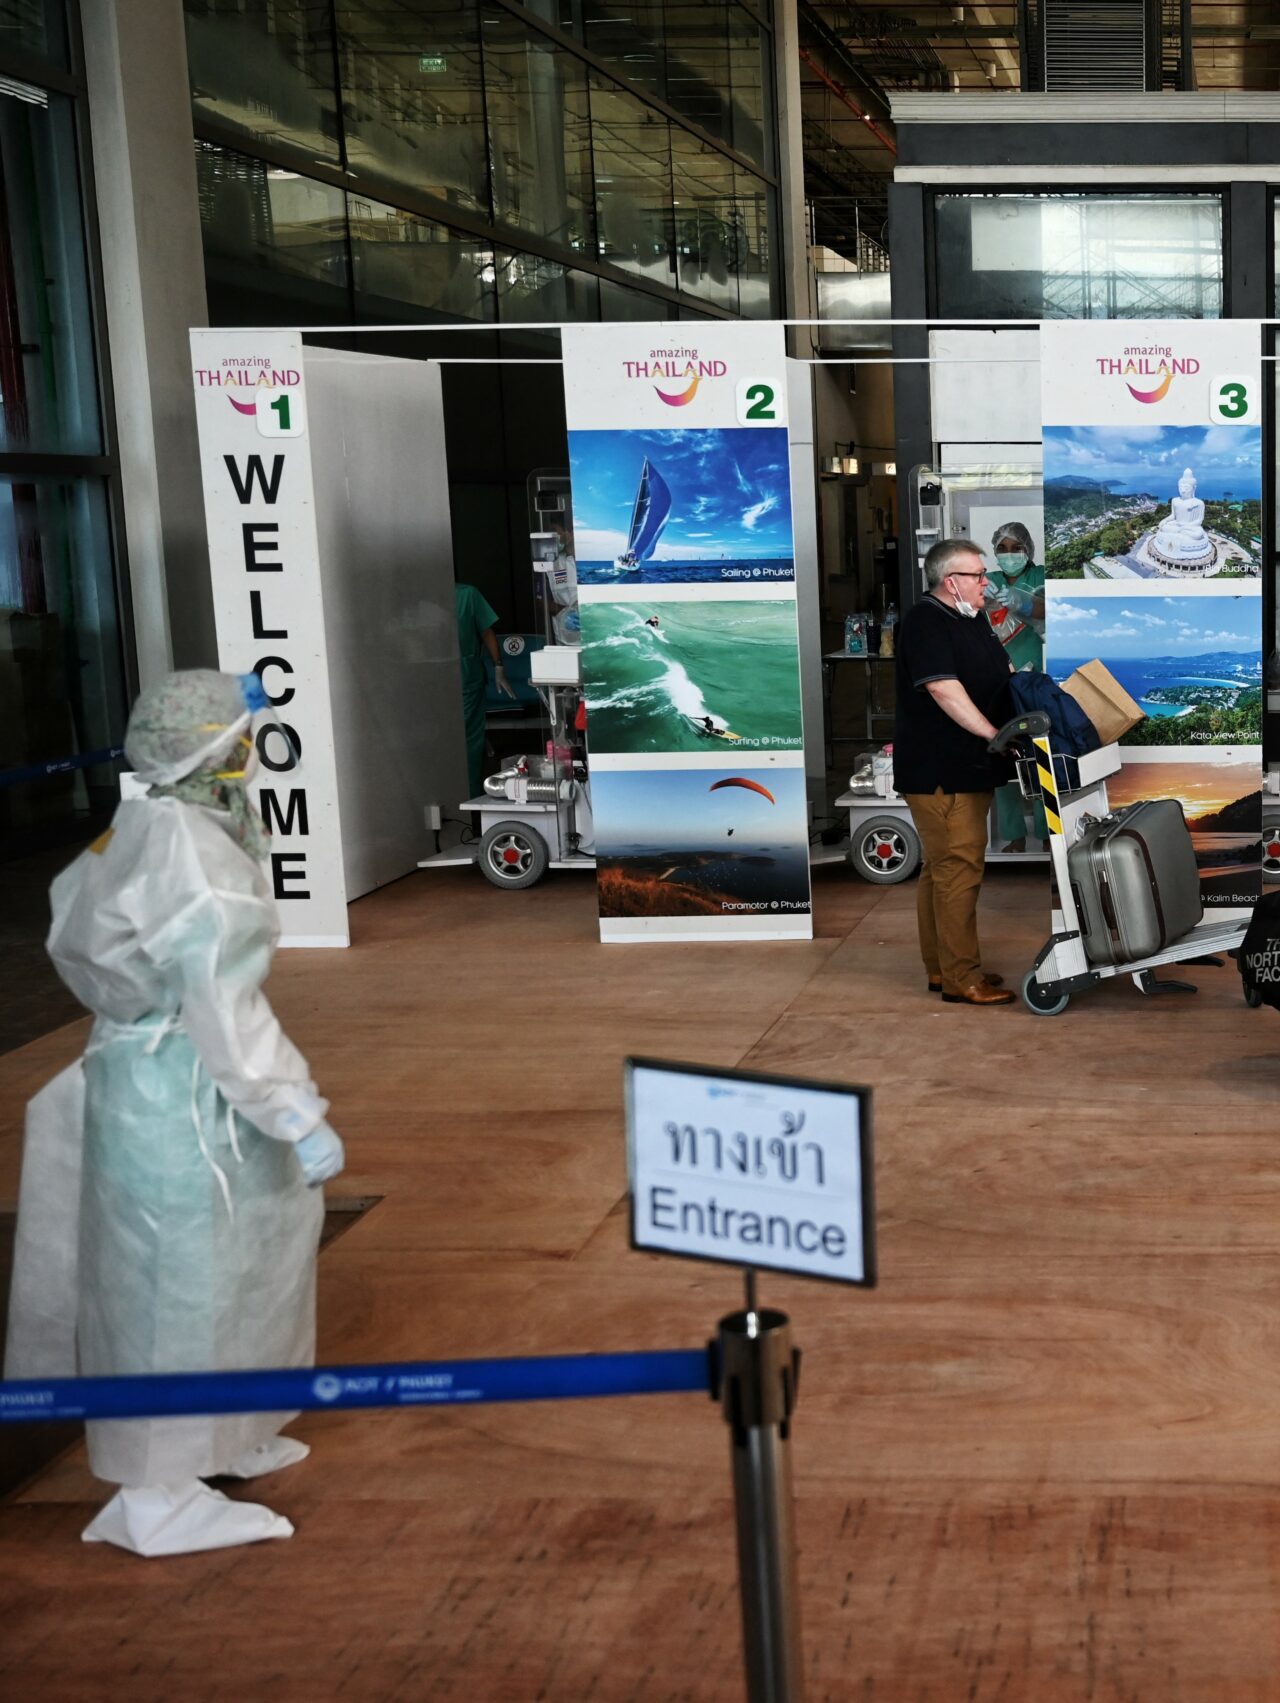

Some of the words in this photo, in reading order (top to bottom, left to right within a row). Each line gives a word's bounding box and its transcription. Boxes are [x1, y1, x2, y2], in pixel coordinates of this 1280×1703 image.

[650, 347, 698, 360] amazing
[1124, 345, 1172, 357] amazing
[222, 356, 271, 369] amazing
[623, 361, 727, 377] THAILAND
[1096, 358, 1200, 375] THAILAND
[195, 370, 300, 386] THAILAND
[746, 384, 776, 419] 2
[1218, 383, 1248, 418] 3
[271, 395, 291, 430] 1
[721, 568, 751, 578] Sailing
[762, 568, 794, 576] Phuket
[1221, 564, 1259, 573] Buddha
[223, 454, 311, 900] WELCOME
[728, 736, 760, 746] Surfing
[771, 736, 803, 745] Phuket
[1190, 731, 1212, 740] Kata
[1213, 731, 1236, 739] View
[1237, 730, 1260, 739] Point
[722, 901, 769, 910] Paramotor
[780, 900, 811, 909] Phuket
[1207, 894, 1230, 903] Kalim
[663, 1110, 826, 1187] ทางเข้า
[649, 1184, 847, 1259] Entrance
